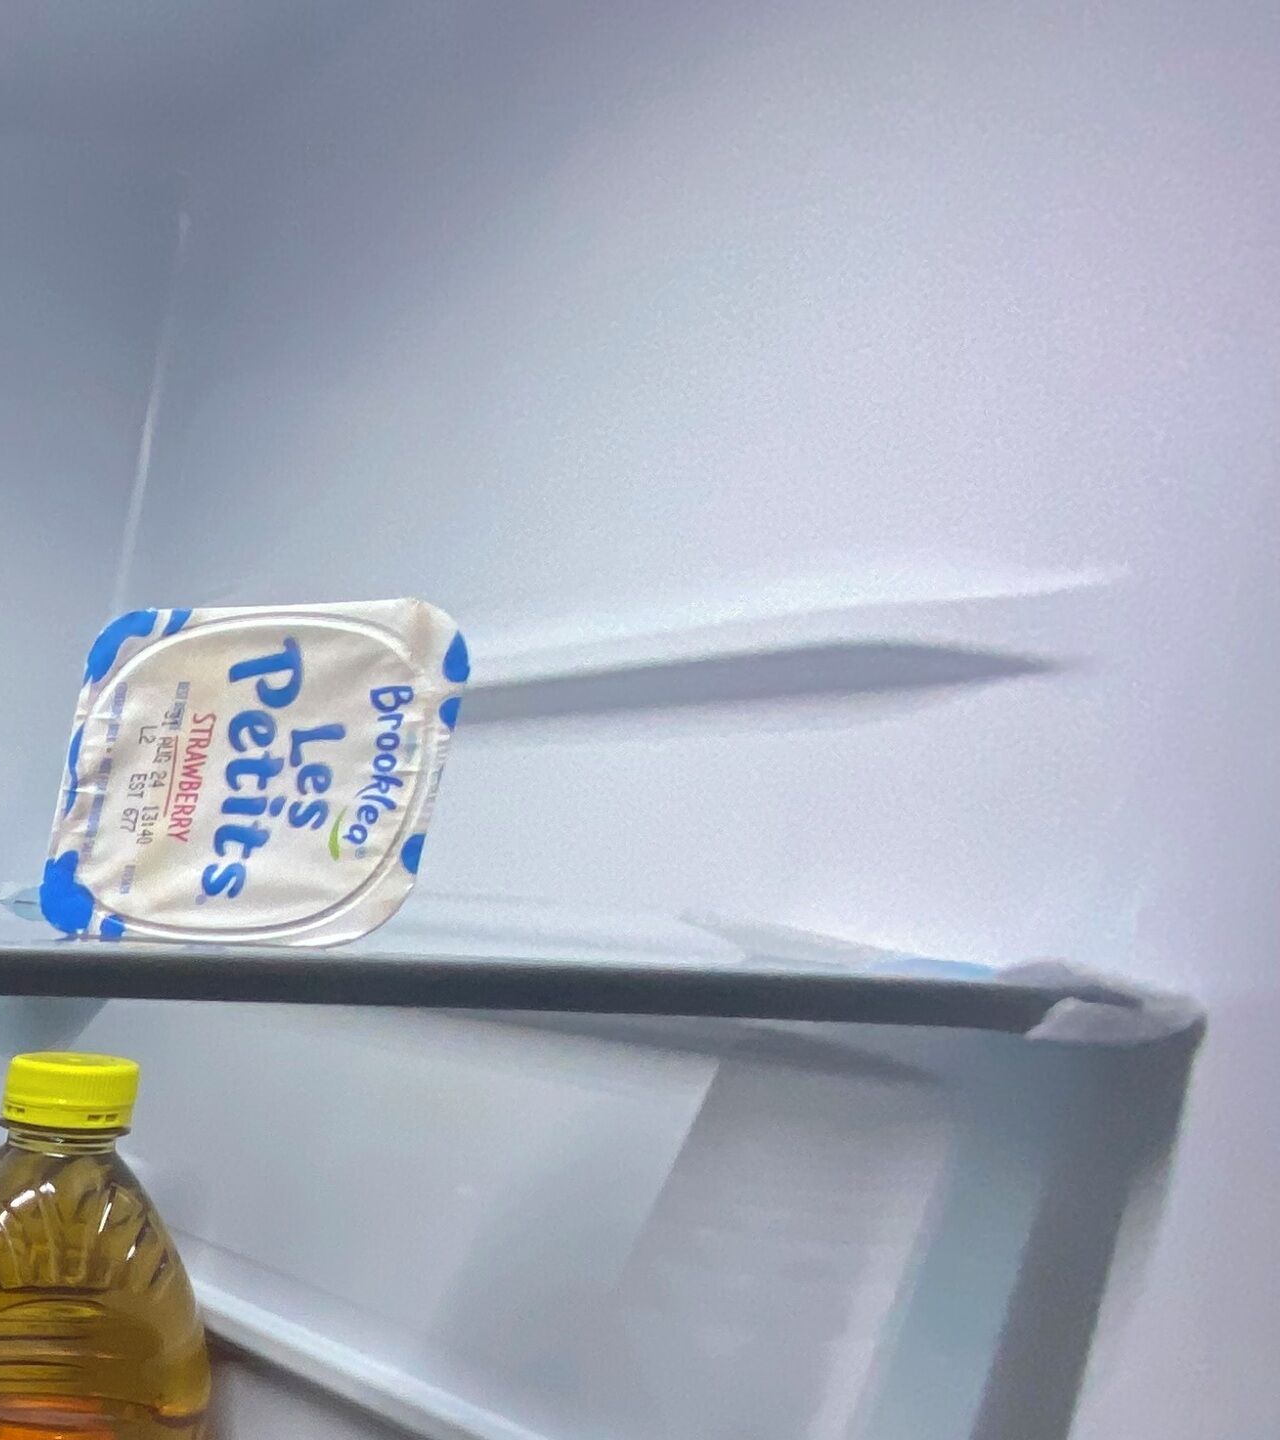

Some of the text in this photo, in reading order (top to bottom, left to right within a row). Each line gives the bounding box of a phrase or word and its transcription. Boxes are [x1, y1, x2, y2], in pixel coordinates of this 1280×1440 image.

[119, 726, 157, 832] L2 EST 677
[151, 772, 168, 788] 24
[153, 736, 171, 764] AUG
[167, 713, 217, 843] STRAWBERRY
[201, 636, 303, 899] Petits
[290, 722, 346, 830] Les
[342, 685, 414, 846] Brooklea
